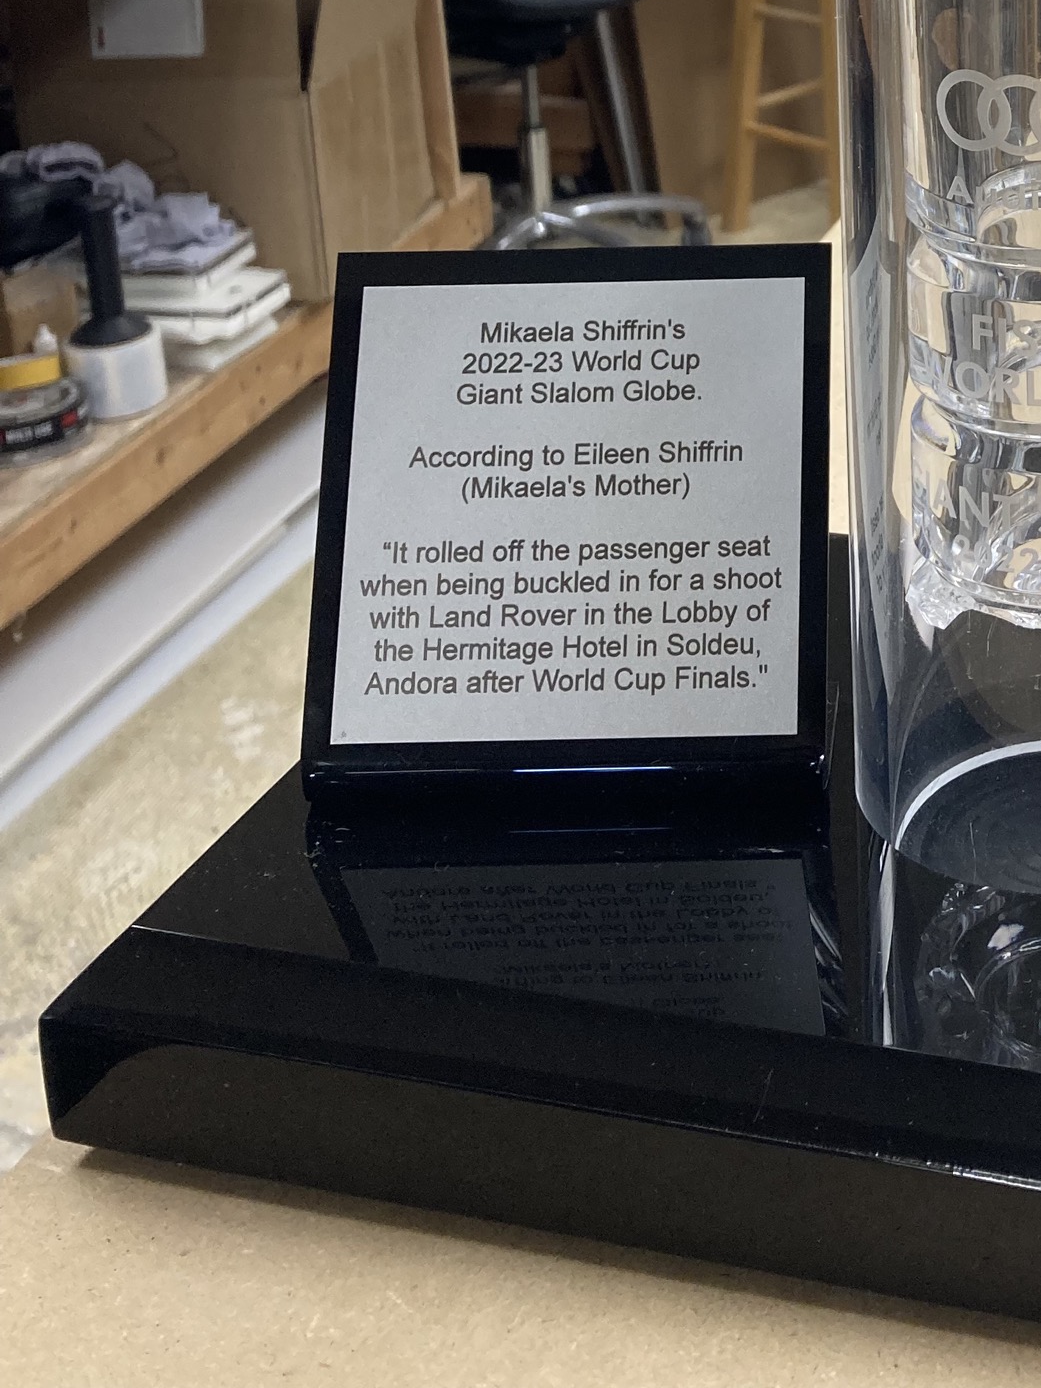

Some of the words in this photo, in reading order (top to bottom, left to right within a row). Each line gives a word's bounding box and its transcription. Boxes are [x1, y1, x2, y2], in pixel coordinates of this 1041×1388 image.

[480, 320, 574, 344] Mikaela
[582, 318, 686, 342] Shiffrin's
[972, 314, 1038, 358] FIS
[461, 351, 563, 375] 2022-23
[571, 349, 642, 373] World
[650, 348, 701, 376] Cup
[456, 382, 524, 406] Giant
[530, 381, 615, 404] Slalom
[622, 379, 702, 402] Globe.
[408, 444, 534, 472] According
[541, 444, 565, 466] to
[574, 442, 650, 466] Eileen
[658, 439, 743, 464] Shiffrin
[461, 474, 586, 505] (Mikaela's
[594, 472, 690, 501] Mother)
[415, 539, 484, 564] rolled
[492, 538, 526, 563] off
[530, 538, 570, 562] the
[578, 540, 711, 567] passenger
[717, 534, 771, 558] seat
[359, 573, 428, 597] when
[436, 572, 505, 601] being
[513, 569, 611, 595] buckled
[619, 569, 640, 593] in
[648, 568, 683, 592] for
[689, 573, 705, 591] a
[713, 566, 782, 591] shoot
[369, 605, 420, 630] with
[429, 604, 492, 629] Land
[500, 603, 578, 627] Rover
[584, 602, 605, 626] in
[613, 601, 653, 625] the
[662, 599, 738, 629] Lobby
[746, 597, 772, 622] of
[373, 638, 414, 663] the
[422, 636, 554, 666] Hermitage
[562, 633, 628, 659] Hotel
[636, 633, 658, 658] in
[666, 631, 761, 659] Soldeu,
[363, 671, 458, 696] Andora
[466, 669, 525, 694] after
[531, 667, 606, 693] World
[614, 666, 666, 696] Cup
